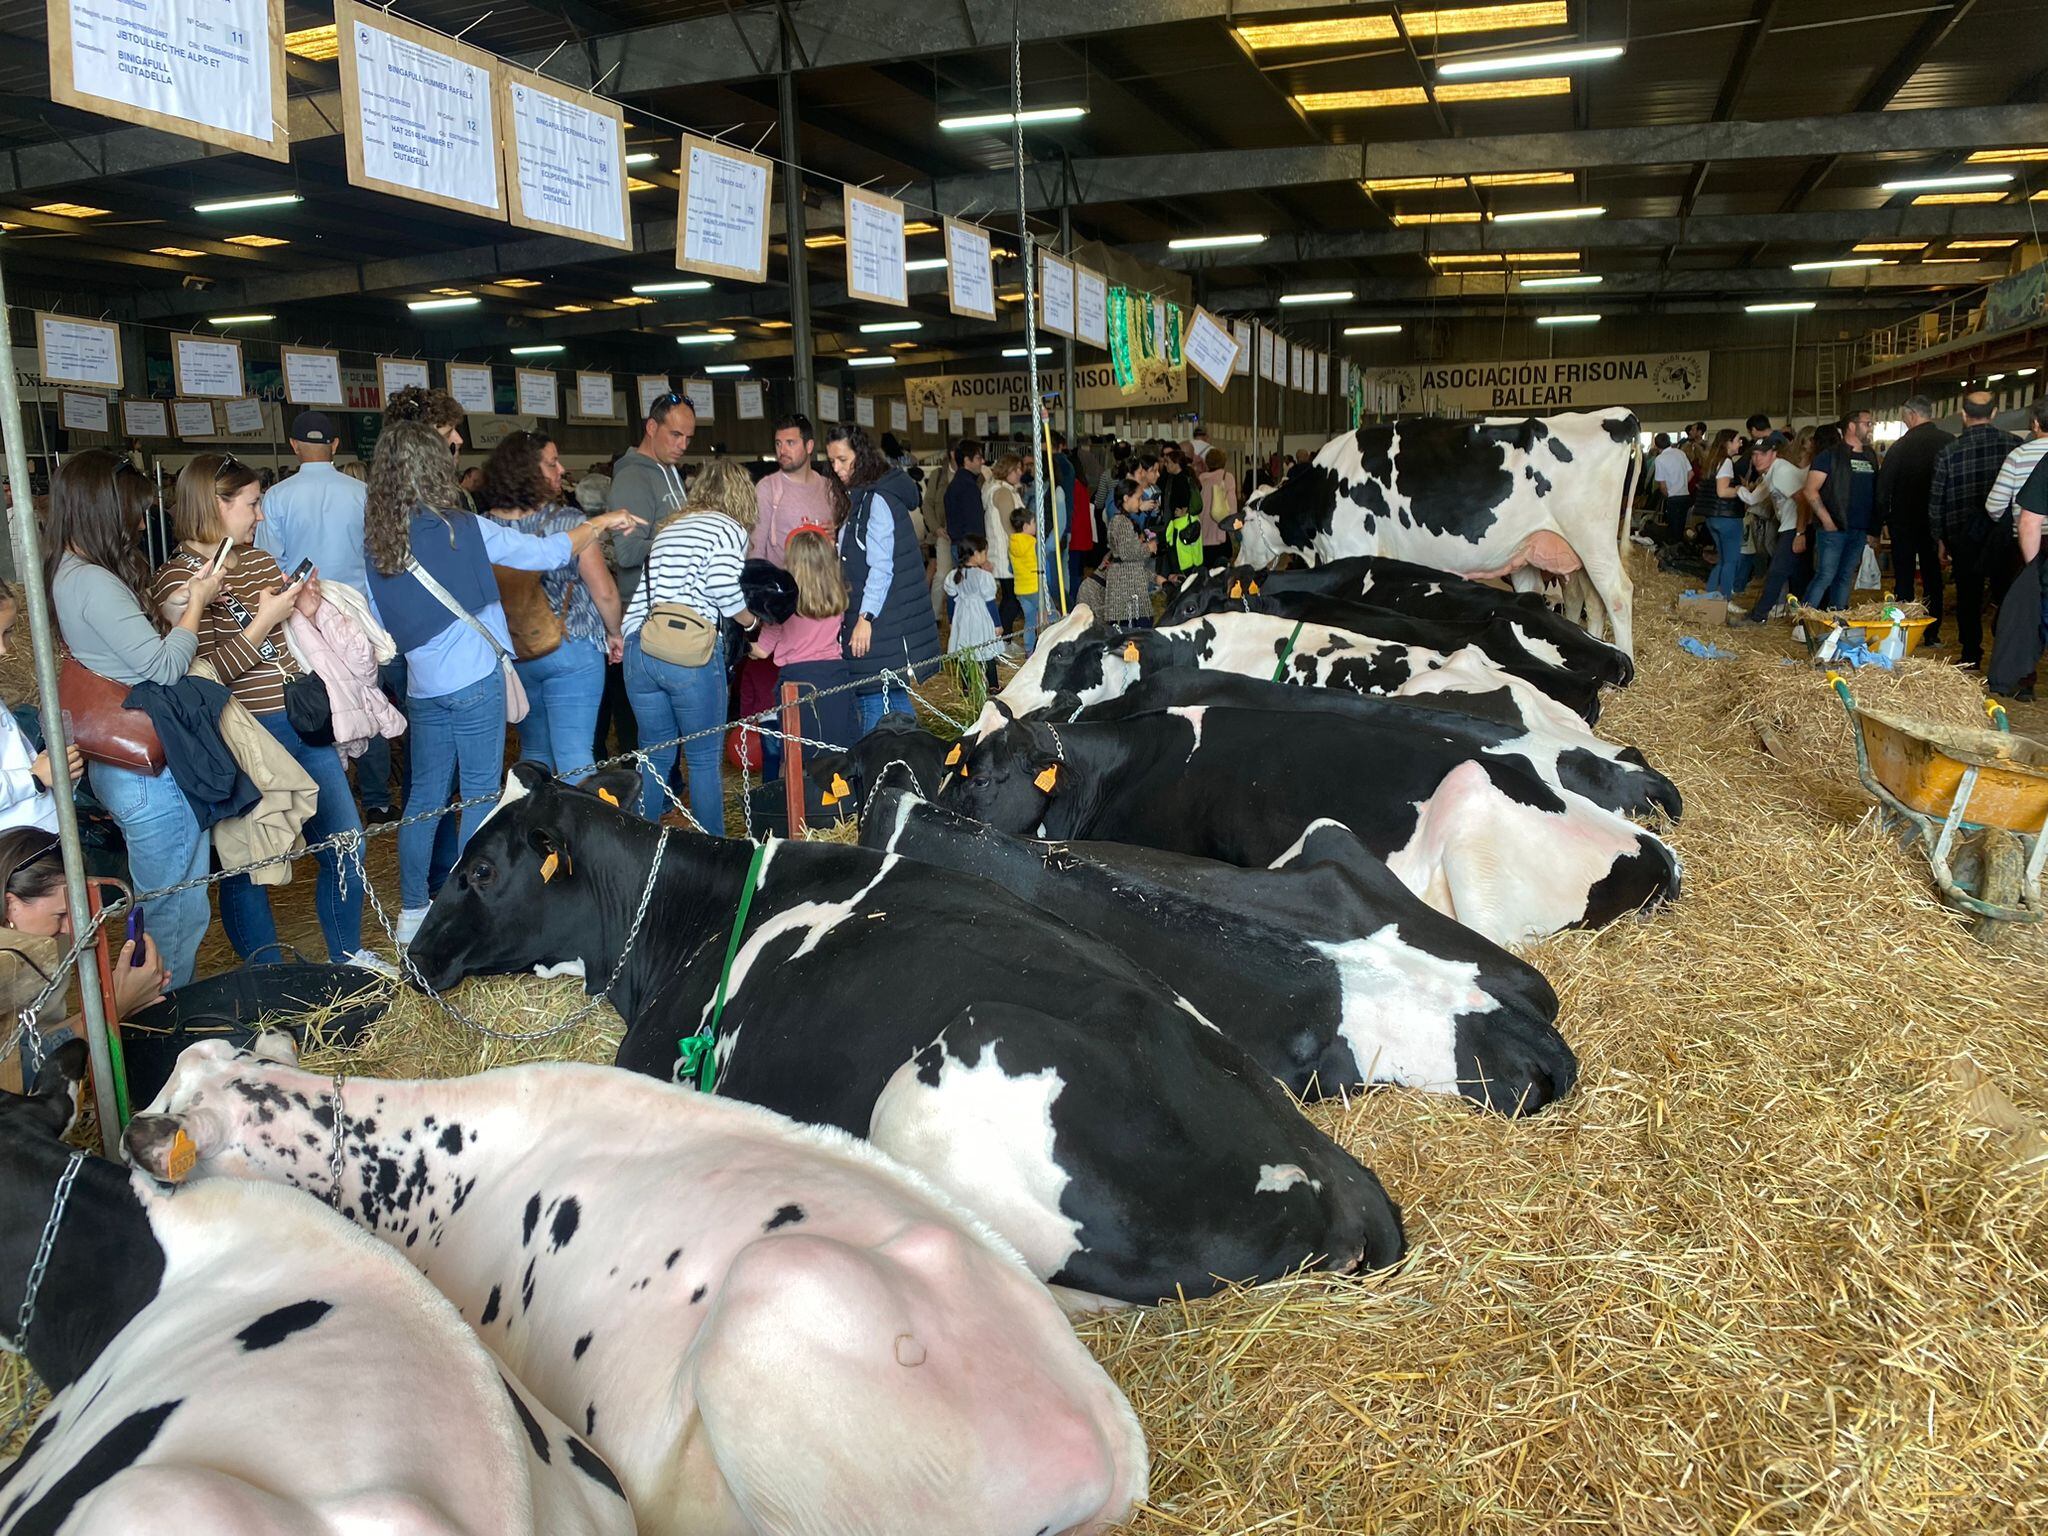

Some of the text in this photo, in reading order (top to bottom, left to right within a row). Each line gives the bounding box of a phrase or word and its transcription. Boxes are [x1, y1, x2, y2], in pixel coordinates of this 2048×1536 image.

[231, 31, 243, 45] 11
[116, 30, 168, 52] JBTOULLEC
[168, 45, 185, 58] THE
[187, 52, 209, 65] ALPS
[210, 58, 220, 68] ET
[118, 50, 169, 72] BINIGAFULL
[118, 62, 173, 85] CIUTADELLA
[467, 120, 476, 132] 12
[391, 125, 404, 135] HAT
[447, 141, 454, 149] ET
[392, 141, 427, 158] BINIGAFULL
[393, 151, 429, 167] CIUTADELLA
[1059, 369, 1117, 390] FRISO
[1423, 360, 1647, 390] ASOCIACIÓN FRISONA
[1010, 394, 1063, 413] BAEA
[1492, 386, 1572, 408] BALEAR
